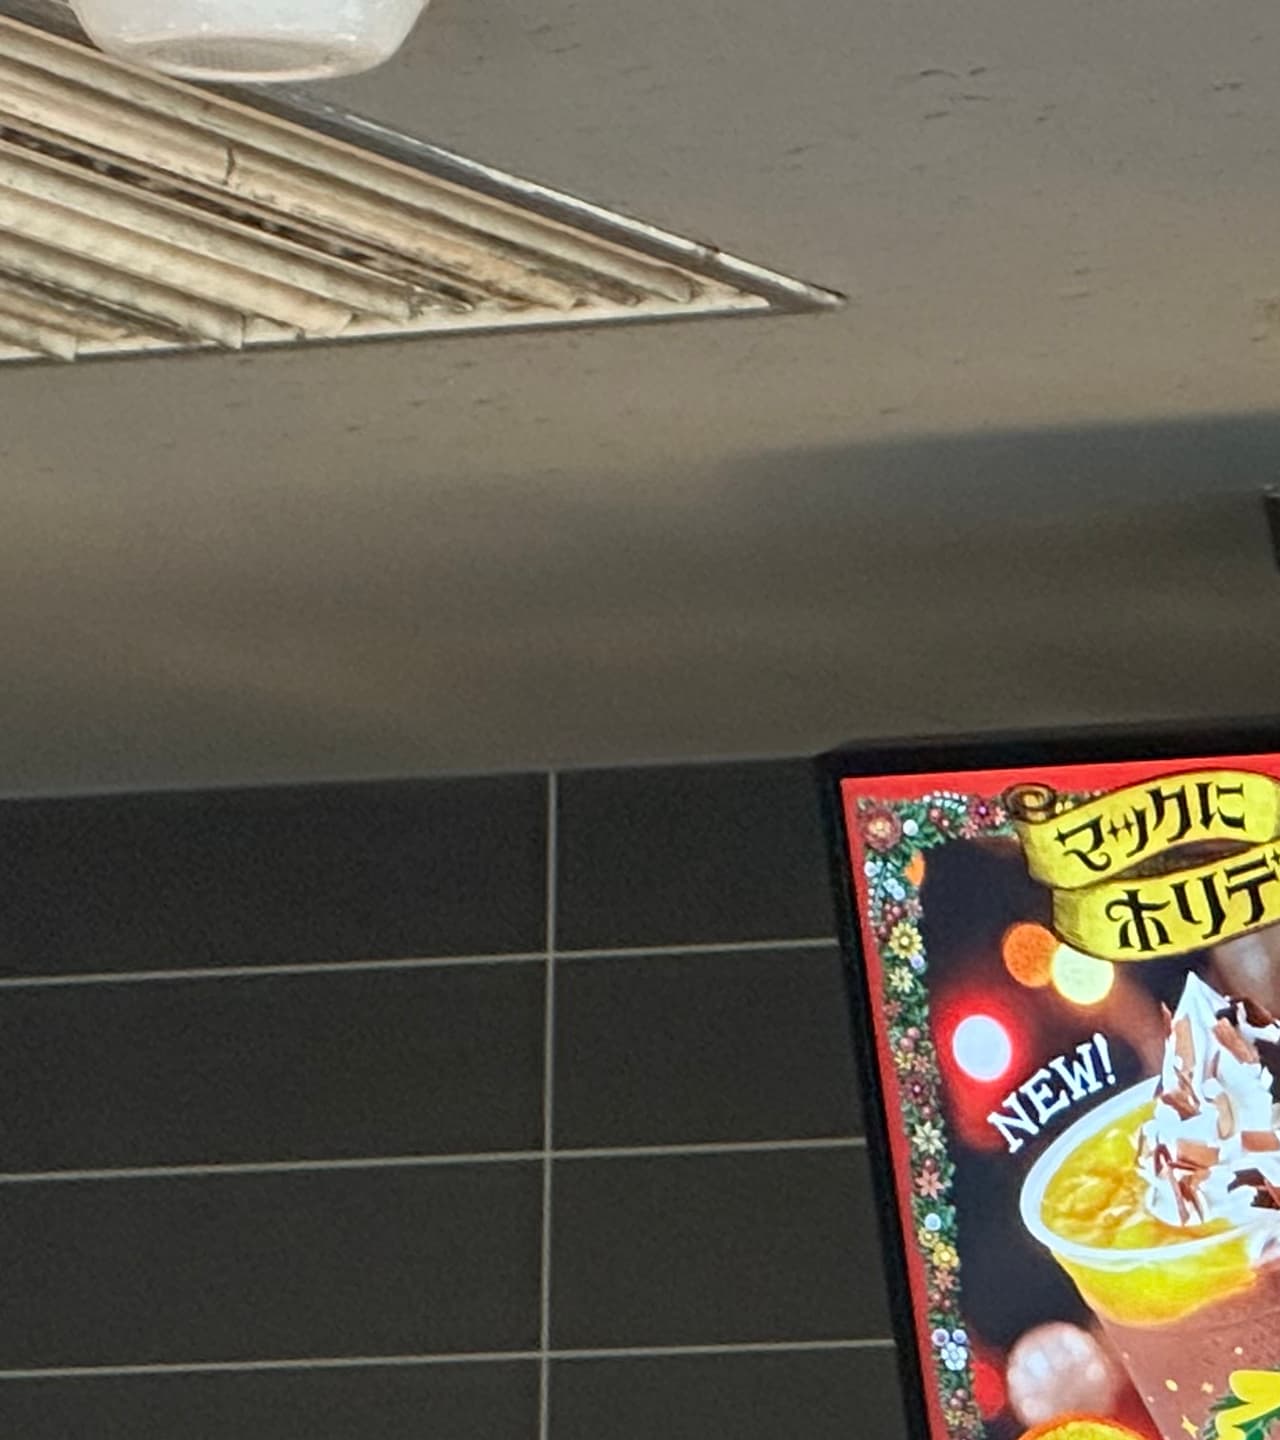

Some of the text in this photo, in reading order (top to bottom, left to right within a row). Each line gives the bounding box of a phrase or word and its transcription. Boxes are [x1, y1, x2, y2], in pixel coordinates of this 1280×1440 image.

[1055, 780, 1246, 872] マックに
[986, 1031, 1115, 1153] NEW!
